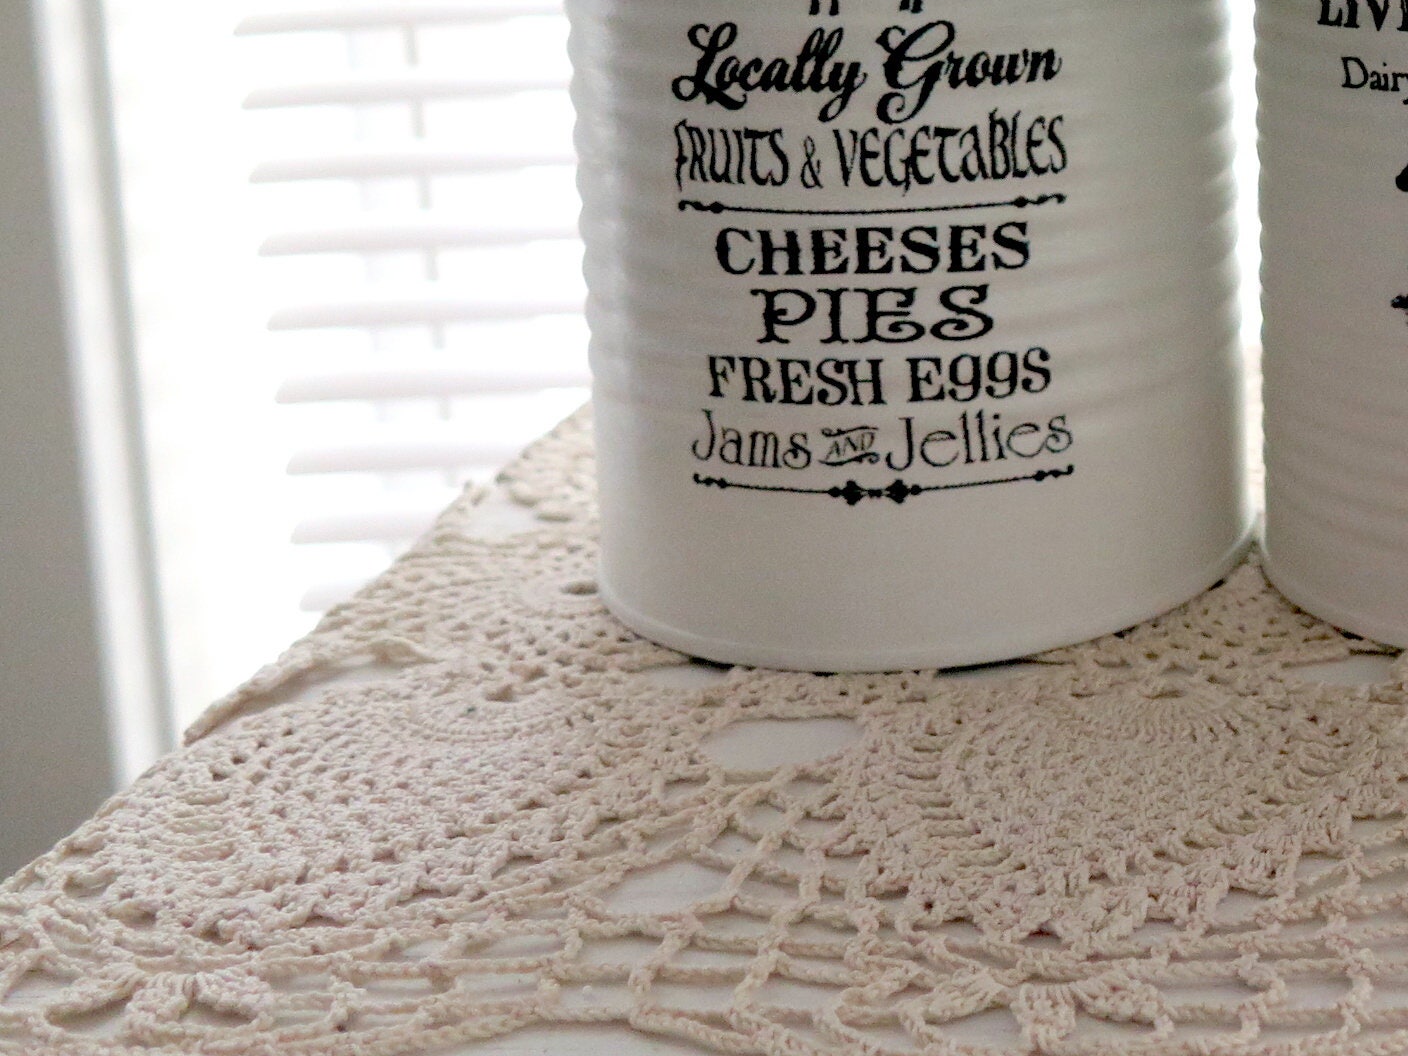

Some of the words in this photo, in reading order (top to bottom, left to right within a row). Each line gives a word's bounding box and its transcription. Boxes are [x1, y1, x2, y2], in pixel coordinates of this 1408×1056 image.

[672, 22, 868, 123] Locally
[875, 20, 1063, 125] Grown
[673, 118, 790, 193] FRUITS
[800, 135, 823, 192] &
[715, 221, 1031, 275] CHEESES
[750, 284, 994, 344] PIES
[708, 354, 887, 405] FRESH
[692, 409, 812, 469] Jams
[823, 430, 877, 462] AND
[885, 409, 1073, 471] Jellies
